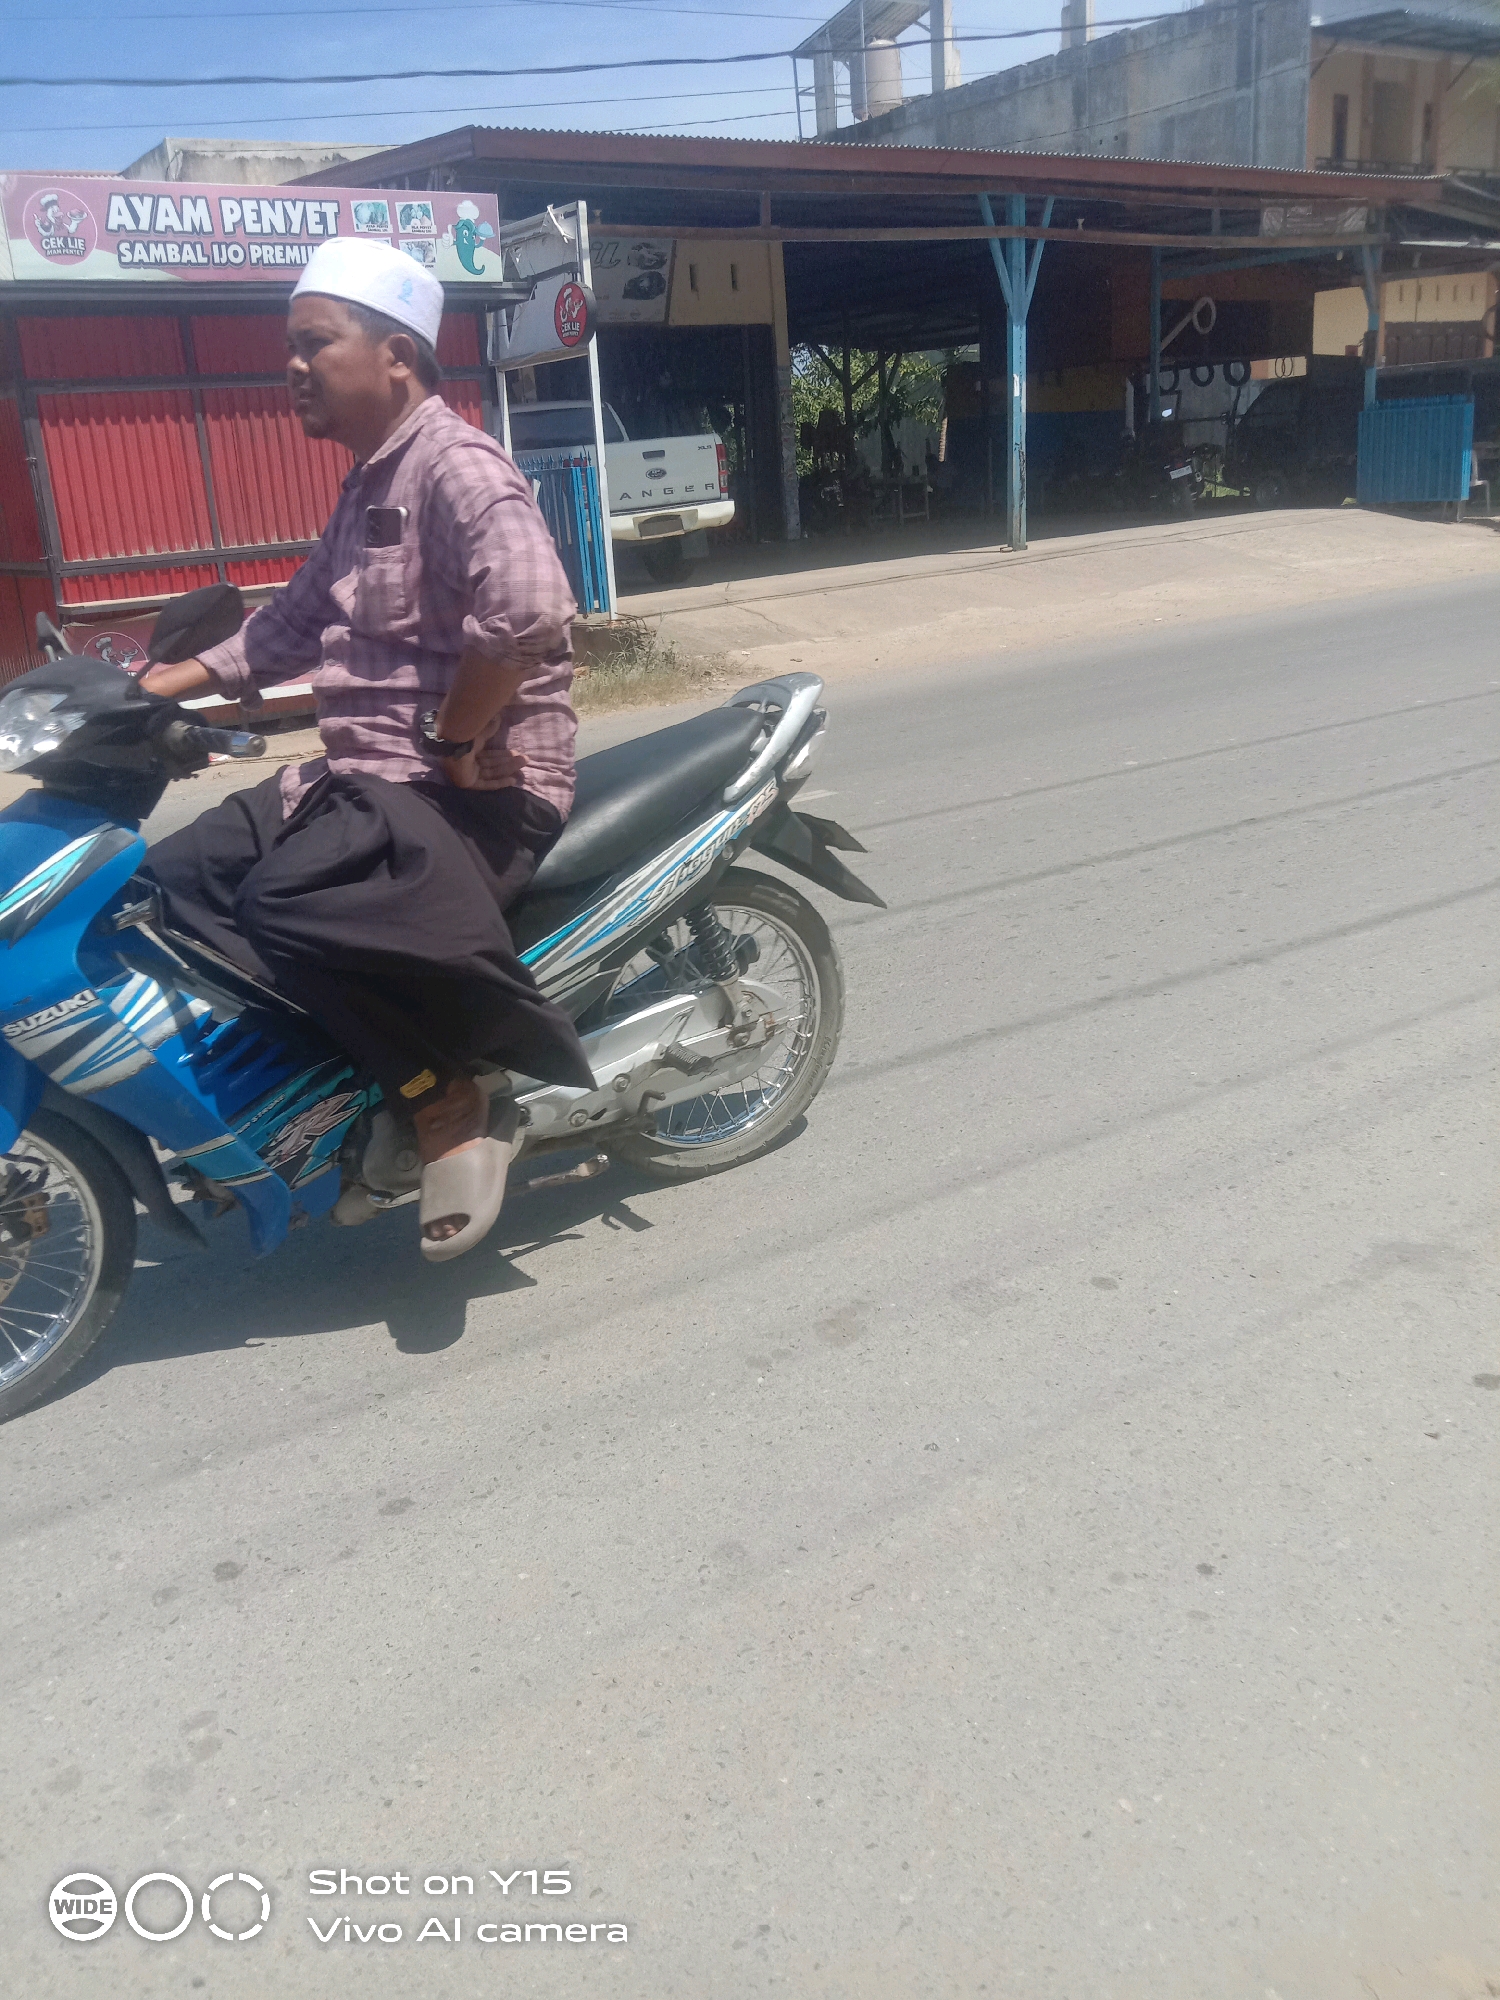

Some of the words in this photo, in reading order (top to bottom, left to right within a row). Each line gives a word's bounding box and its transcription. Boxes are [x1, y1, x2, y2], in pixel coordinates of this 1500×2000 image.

[106, 194, 213, 234] AYAM
[220, 199, 339, 236] PENYET
[41, 237, 65, 250] CEK
[67, 237, 85, 251] LIE
[119, 241, 209, 265] SAMBAL
[213, 243, 246, 265] IJO
[619, 482, 715, 501] ANGER
[2, 988, 98, 1038] SUZUKI
